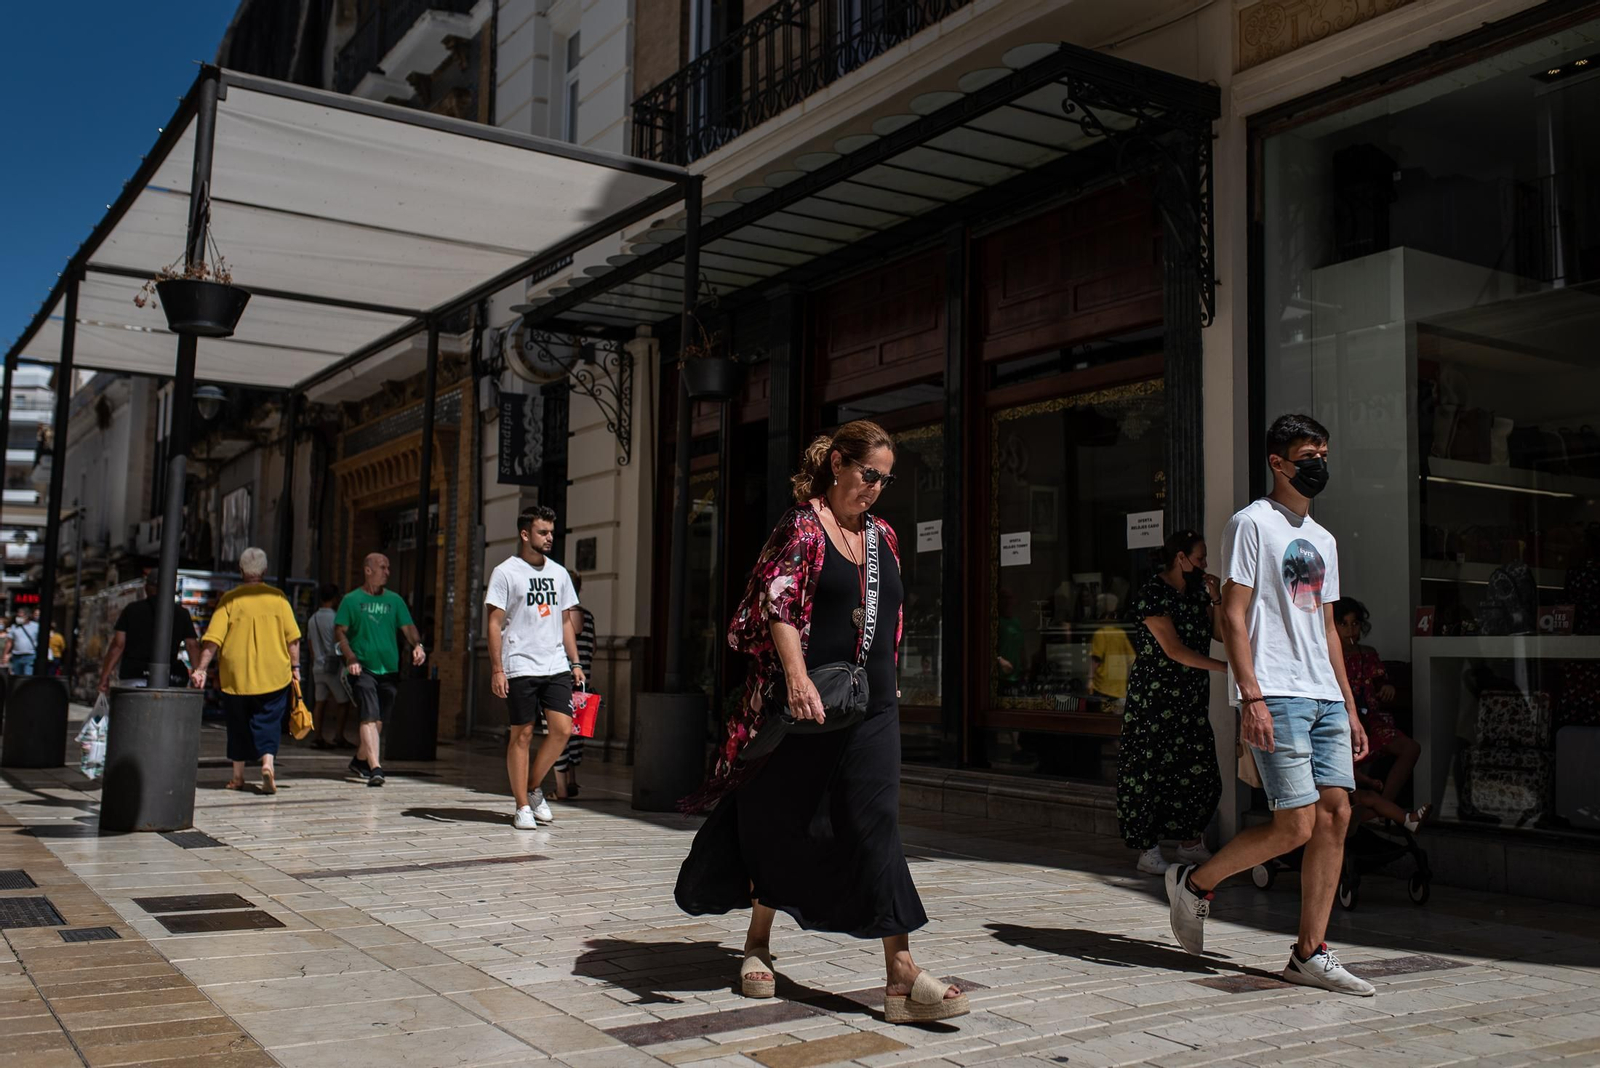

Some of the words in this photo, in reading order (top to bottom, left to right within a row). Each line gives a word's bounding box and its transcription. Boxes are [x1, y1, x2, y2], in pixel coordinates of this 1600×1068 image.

[500, 403, 513, 475] Serendipia
[529, 578, 555, 592] JUST
[527, 592, 545, 606] DO
[546, 592, 558, 606] IT.
[360, 602, 391, 614] PUMA
